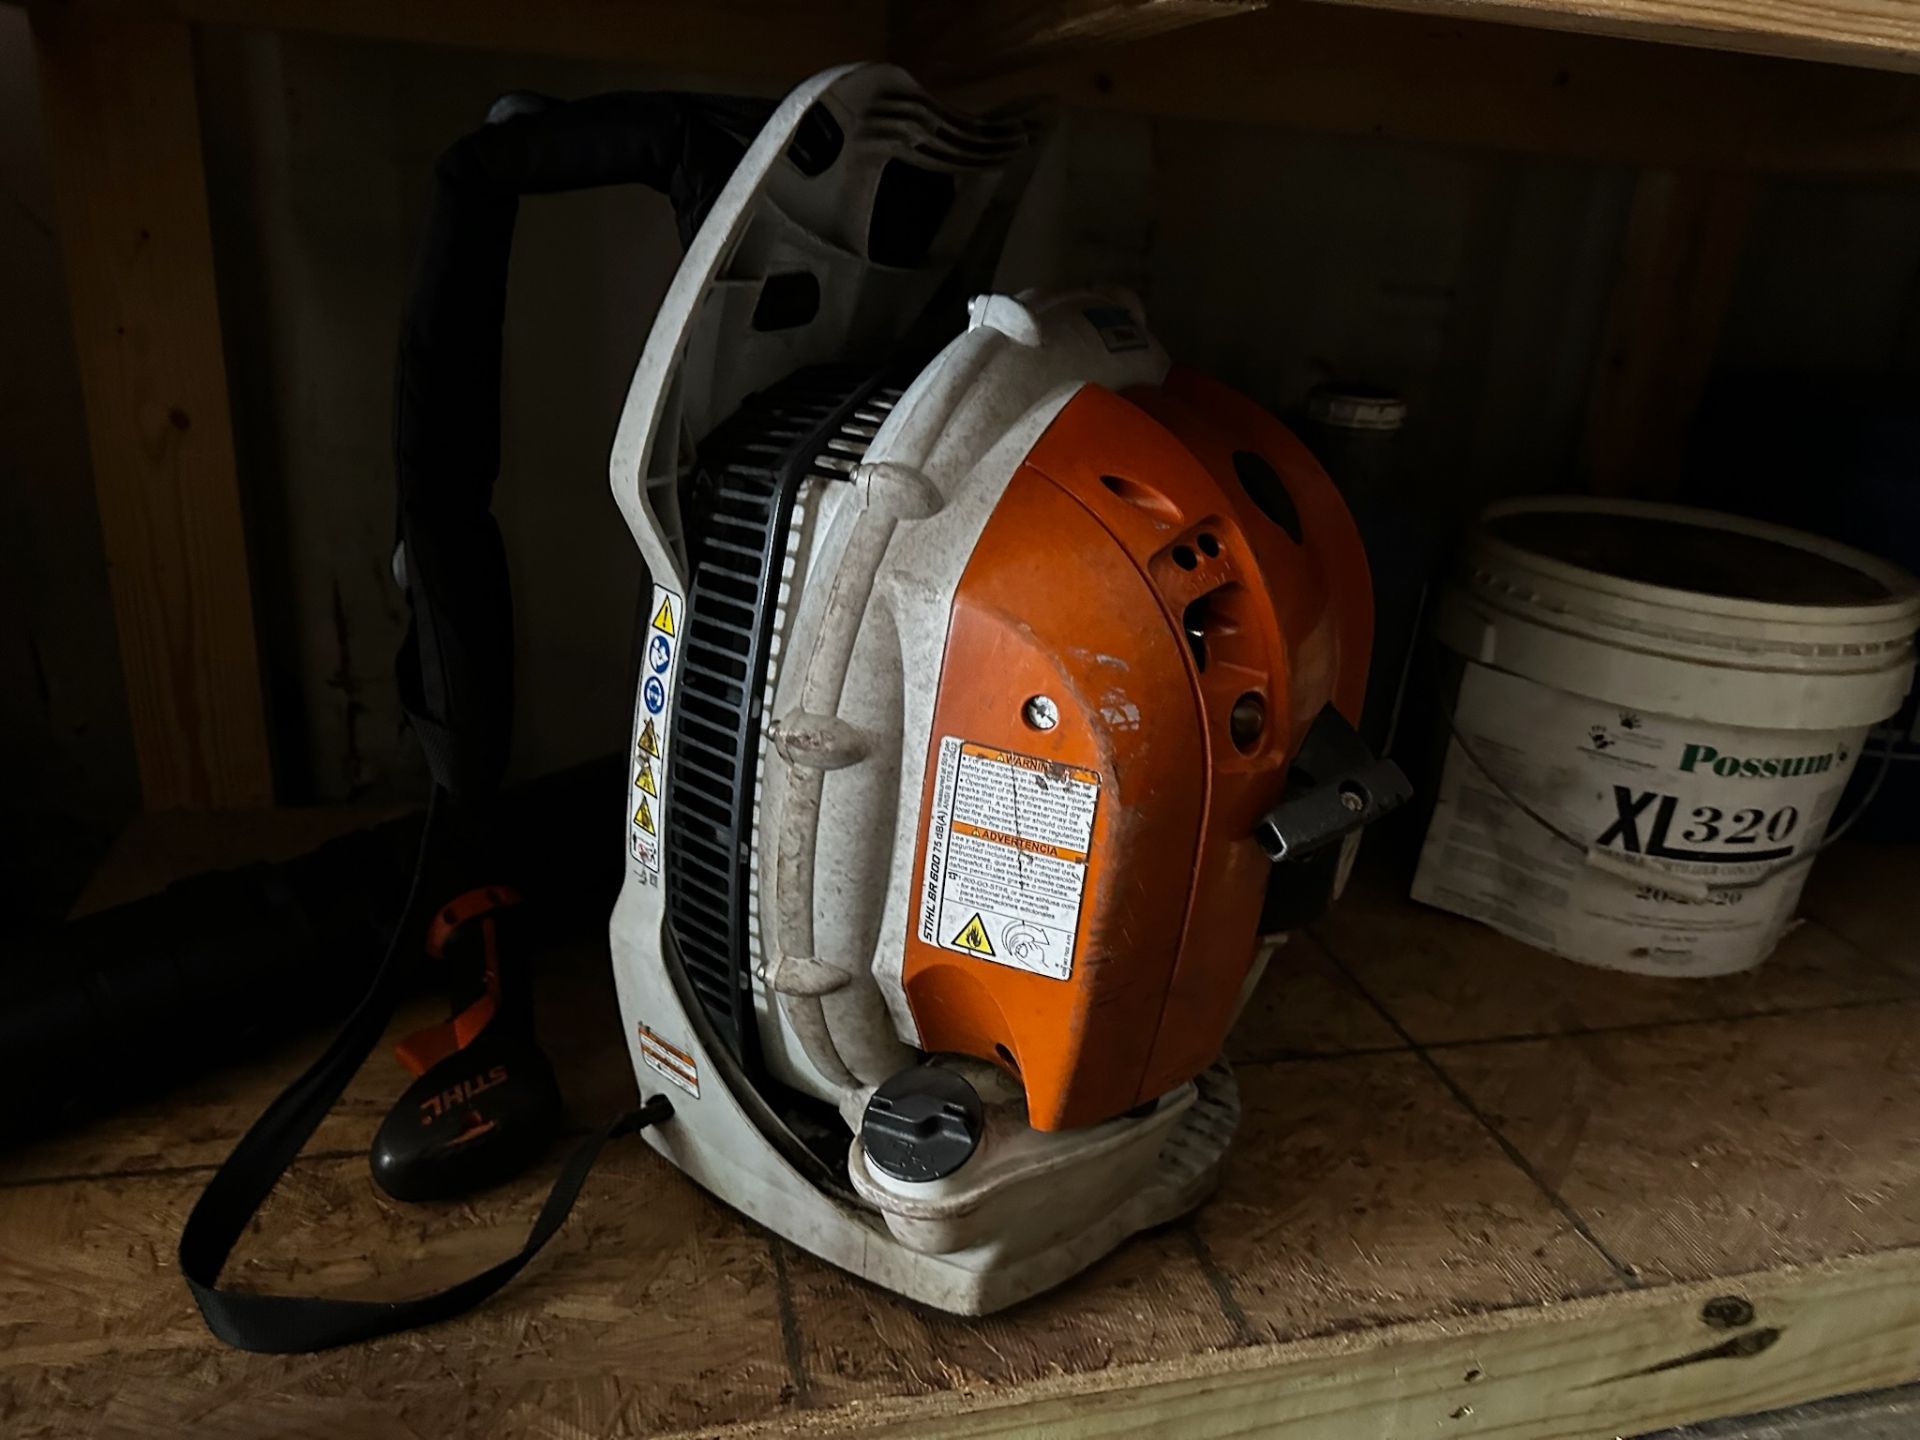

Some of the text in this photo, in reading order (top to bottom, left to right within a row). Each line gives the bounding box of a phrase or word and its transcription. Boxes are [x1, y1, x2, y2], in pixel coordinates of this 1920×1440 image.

[1006, 753, 1049, 772] WARNIN
[934, 809, 948, 840] dB(A)
[1683, 805, 1798, 844] 320
[982, 829, 1058, 856] ADVERTENCIA
[929, 853, 941, 881] 600
